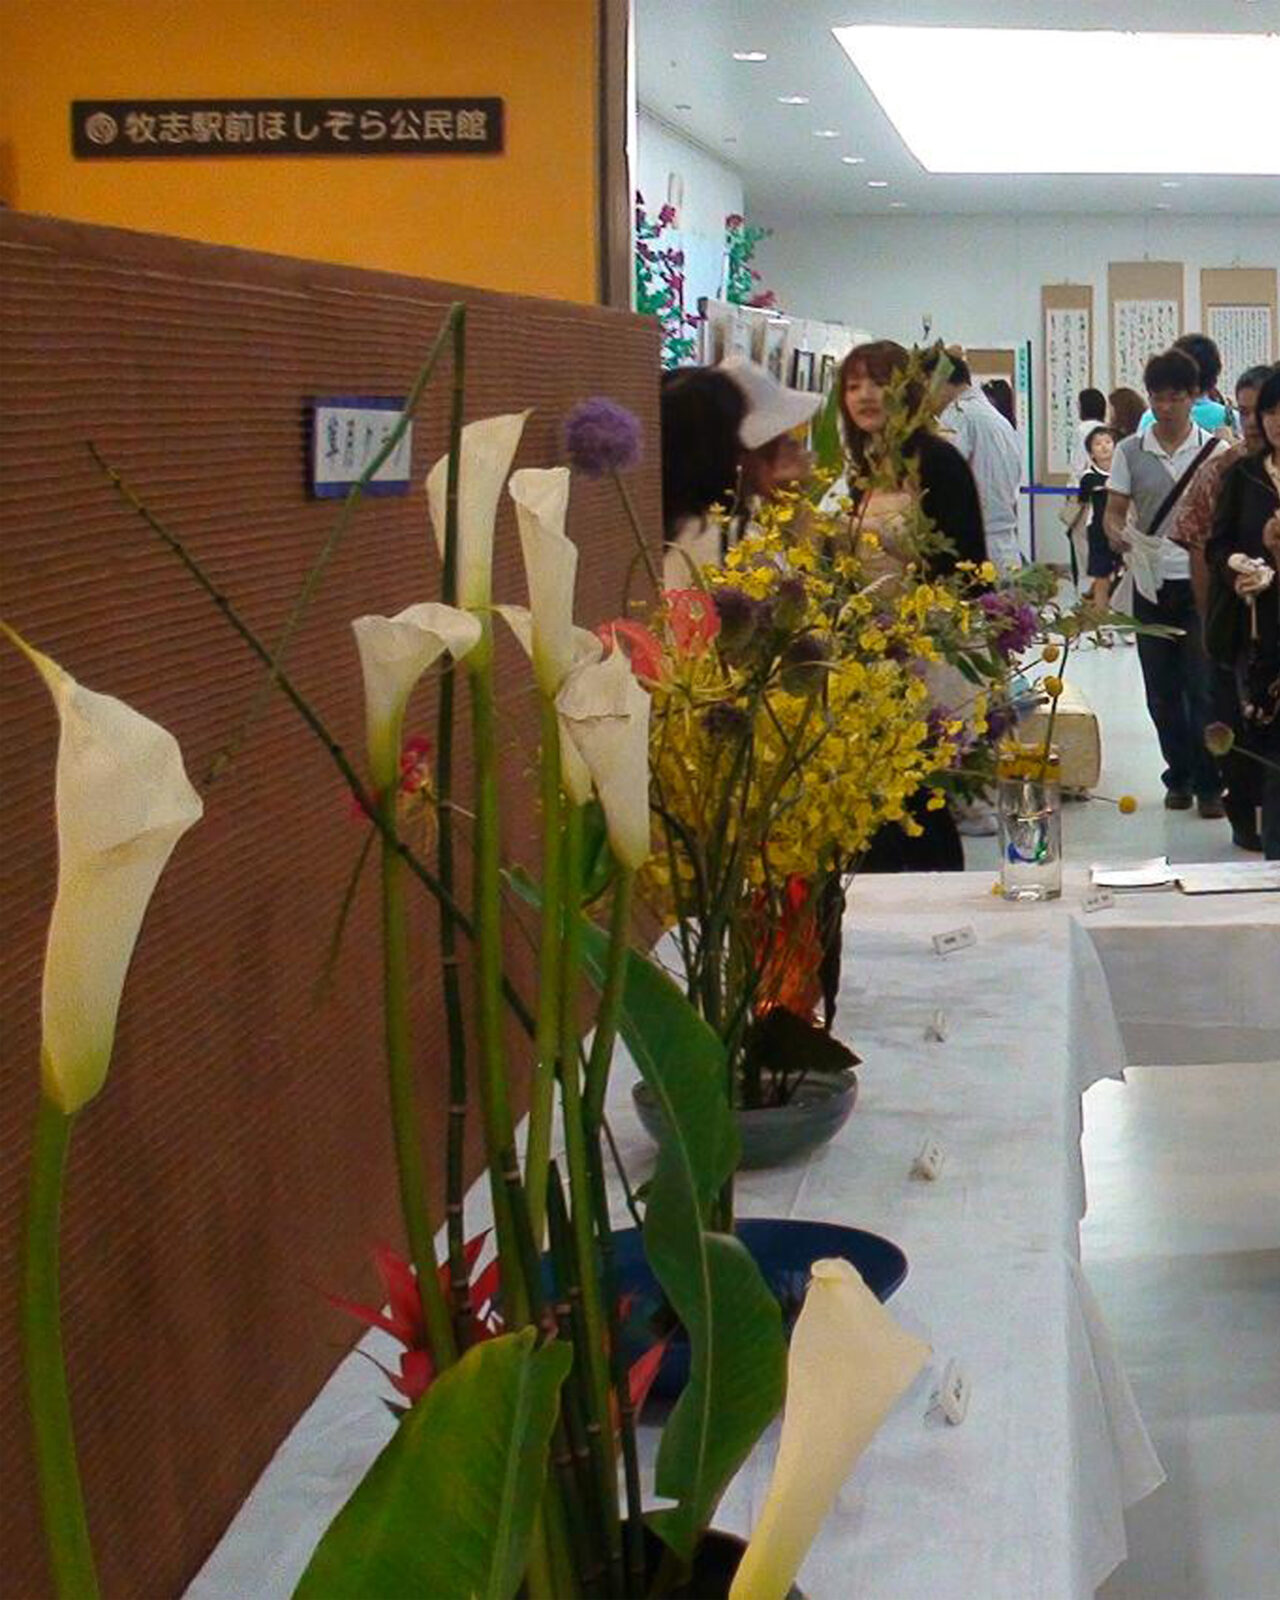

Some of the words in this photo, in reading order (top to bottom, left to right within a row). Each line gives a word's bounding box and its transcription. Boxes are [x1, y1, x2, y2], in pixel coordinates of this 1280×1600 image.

[125, 109, 488, 143] 牧志駅前ほしぞら公民館
